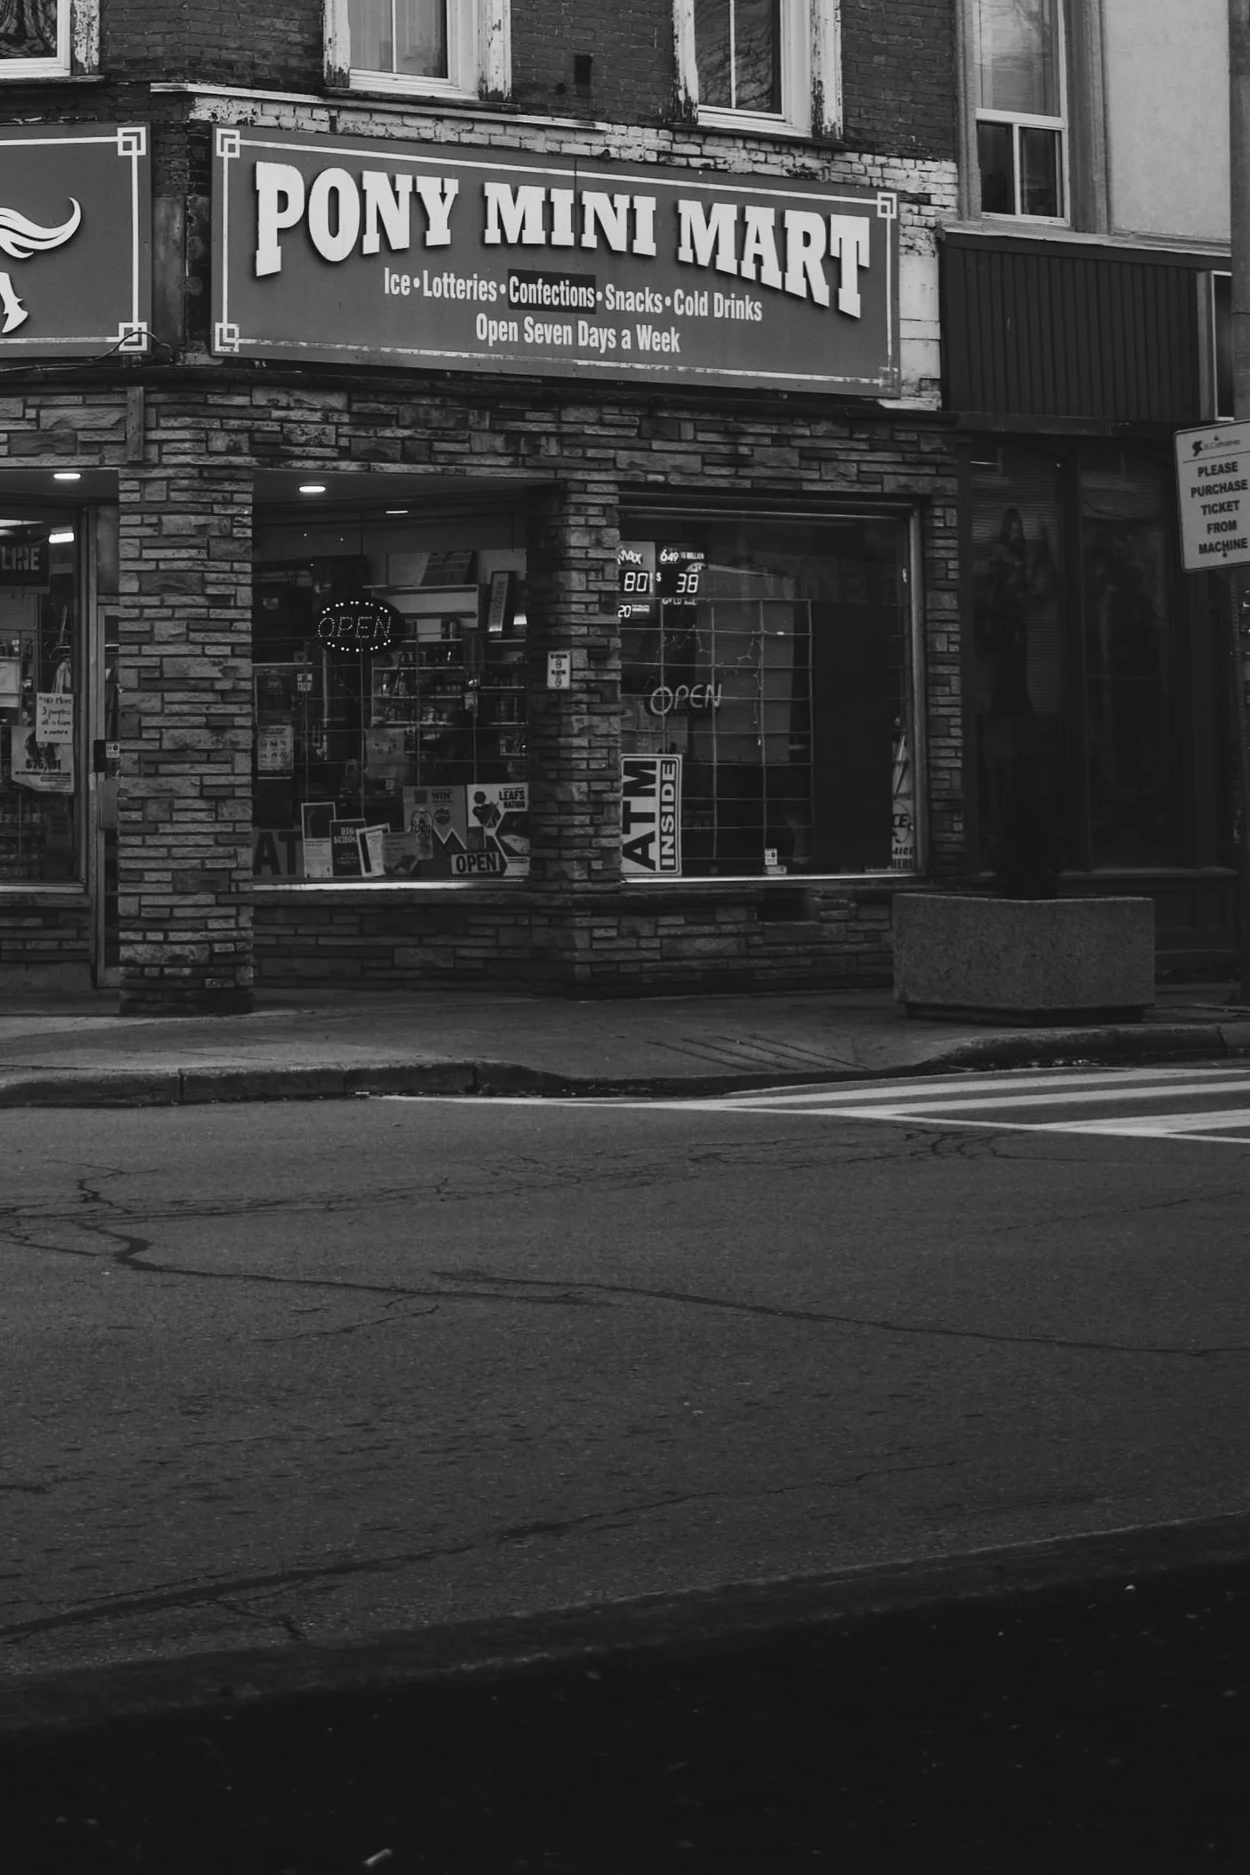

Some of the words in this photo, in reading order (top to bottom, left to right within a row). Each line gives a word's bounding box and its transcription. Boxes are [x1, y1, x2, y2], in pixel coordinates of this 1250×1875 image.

[255, 161, 459, 277] PONY
[484, 182, 657, 256] MINI
[678, 199, 870, 318] MART
[384, 267, 411, 296] Ice
[422, 269, 498, 302] Lotteries
[509, 275, 595, 308] Confections
[605, 283, 663, 314] Snacks
[673, 288, 709, 317] Cold
[713, 291, 763, 322] Drinks
[475, 312, 519, 347] Open
[523, 315, 573, 346] Seven
[577, 320, 617, 354] Days
[621, 328, 632, 350] a
[635, 323, 681, 353] Week
[1197, 461, 1239, 478] PLEASE
[1190, 479, 1248, 498] PURCHASE
[1201, 500, 1240, 516] TICKET
[1206, 520, 1237, 535] FROM
[1198, 538, 1248, 555] MACHINE
[617, 550, 643, 565] MAX
[623, 571, 649, 592] 80
[675, 573, 699, 593] 38
[317, 615, 393, 640] OPEN
[650, 682, 722, 716] OPEN
[498, 789, 526, 801] LEAFS
[621, 760, 657, 872] ATM
[661, 763, 676, 866] INSIDE
[252, 831, 303, 875] AT
[456, 853, 496, 873] OPEN
